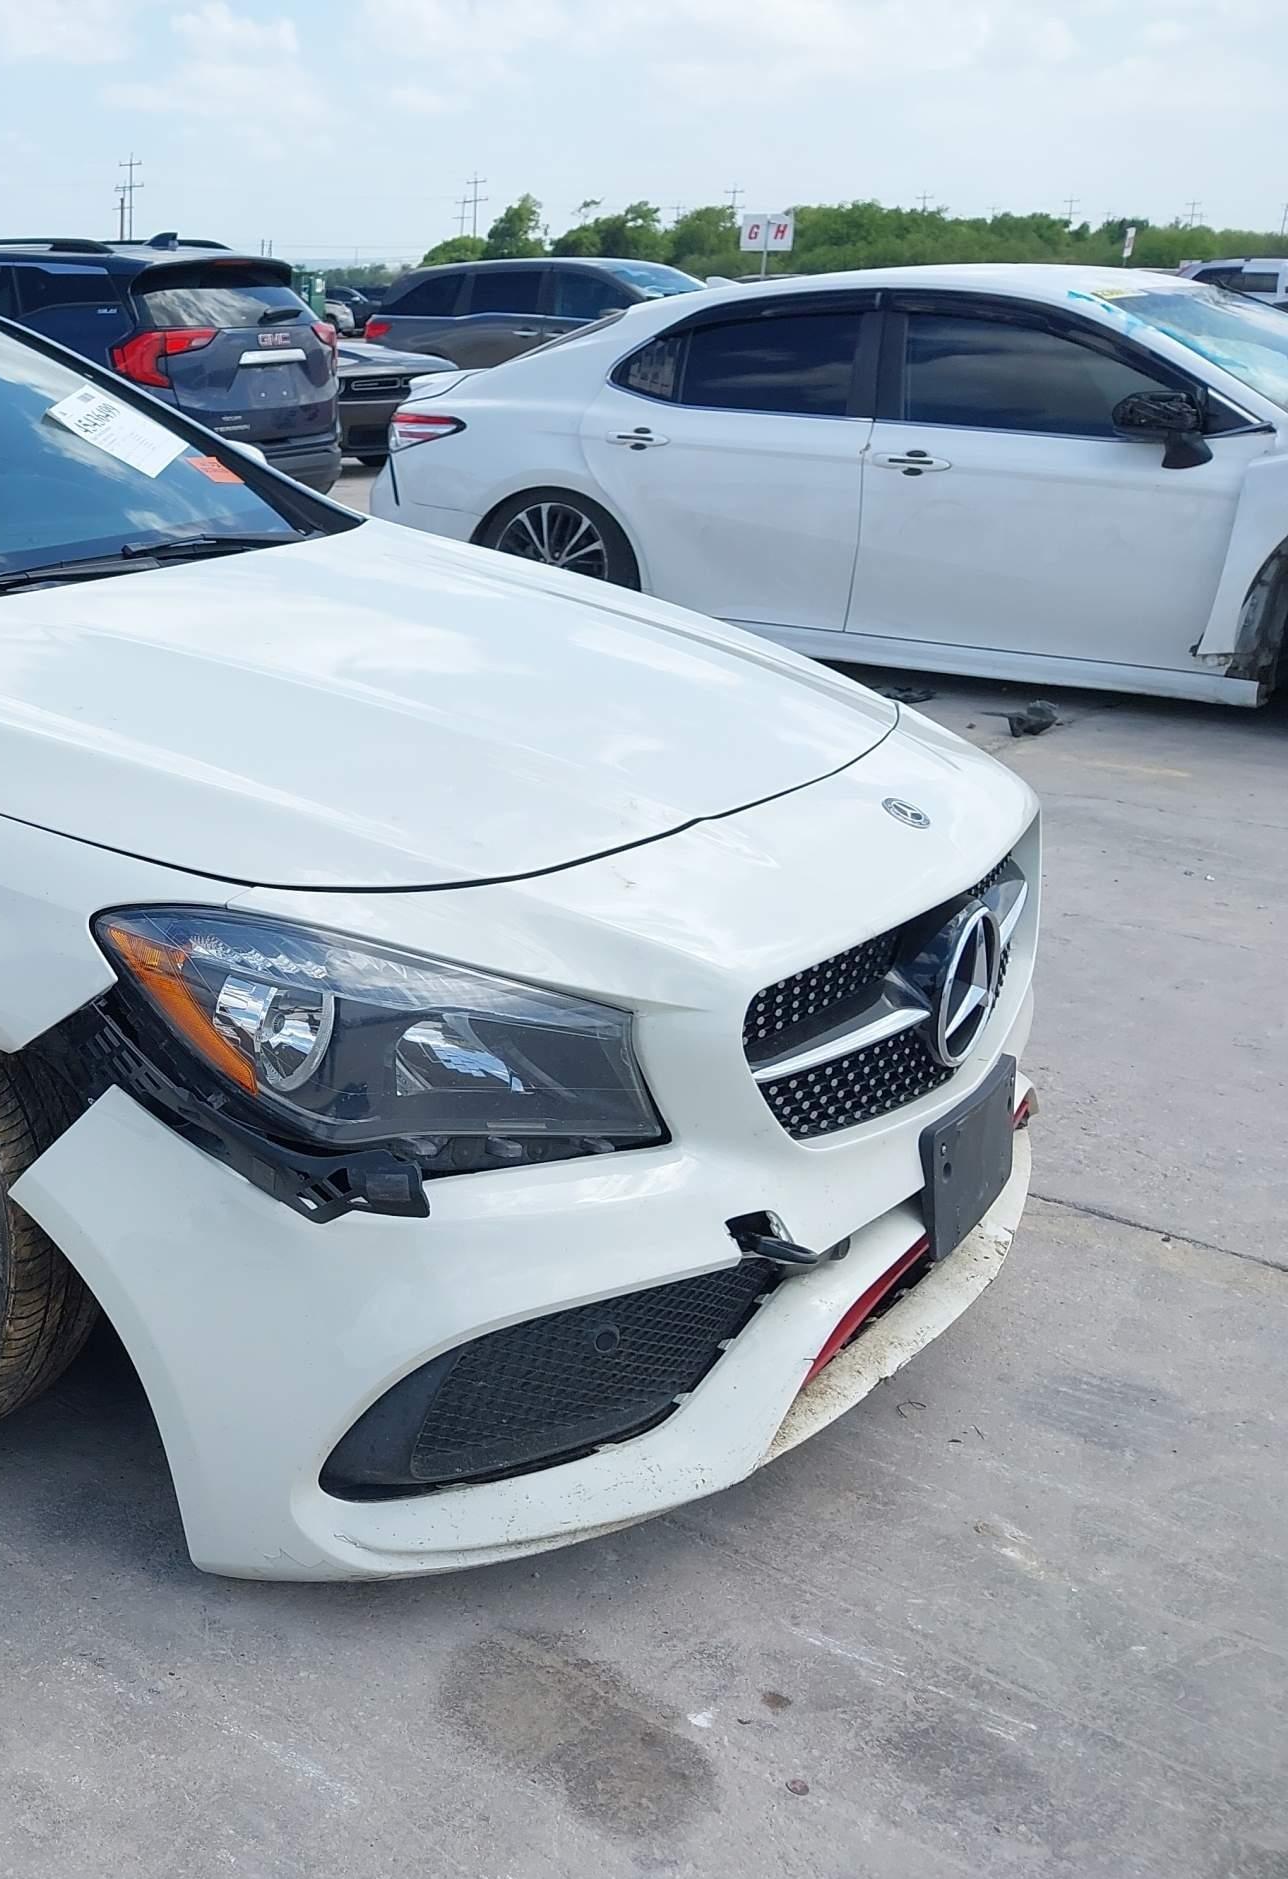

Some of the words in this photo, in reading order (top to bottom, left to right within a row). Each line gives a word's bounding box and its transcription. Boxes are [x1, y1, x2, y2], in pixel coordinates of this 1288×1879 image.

[748, 223, 760, 240] G
[774, 223, 787, 240] H
[257, 332, 291, 346] GMC
